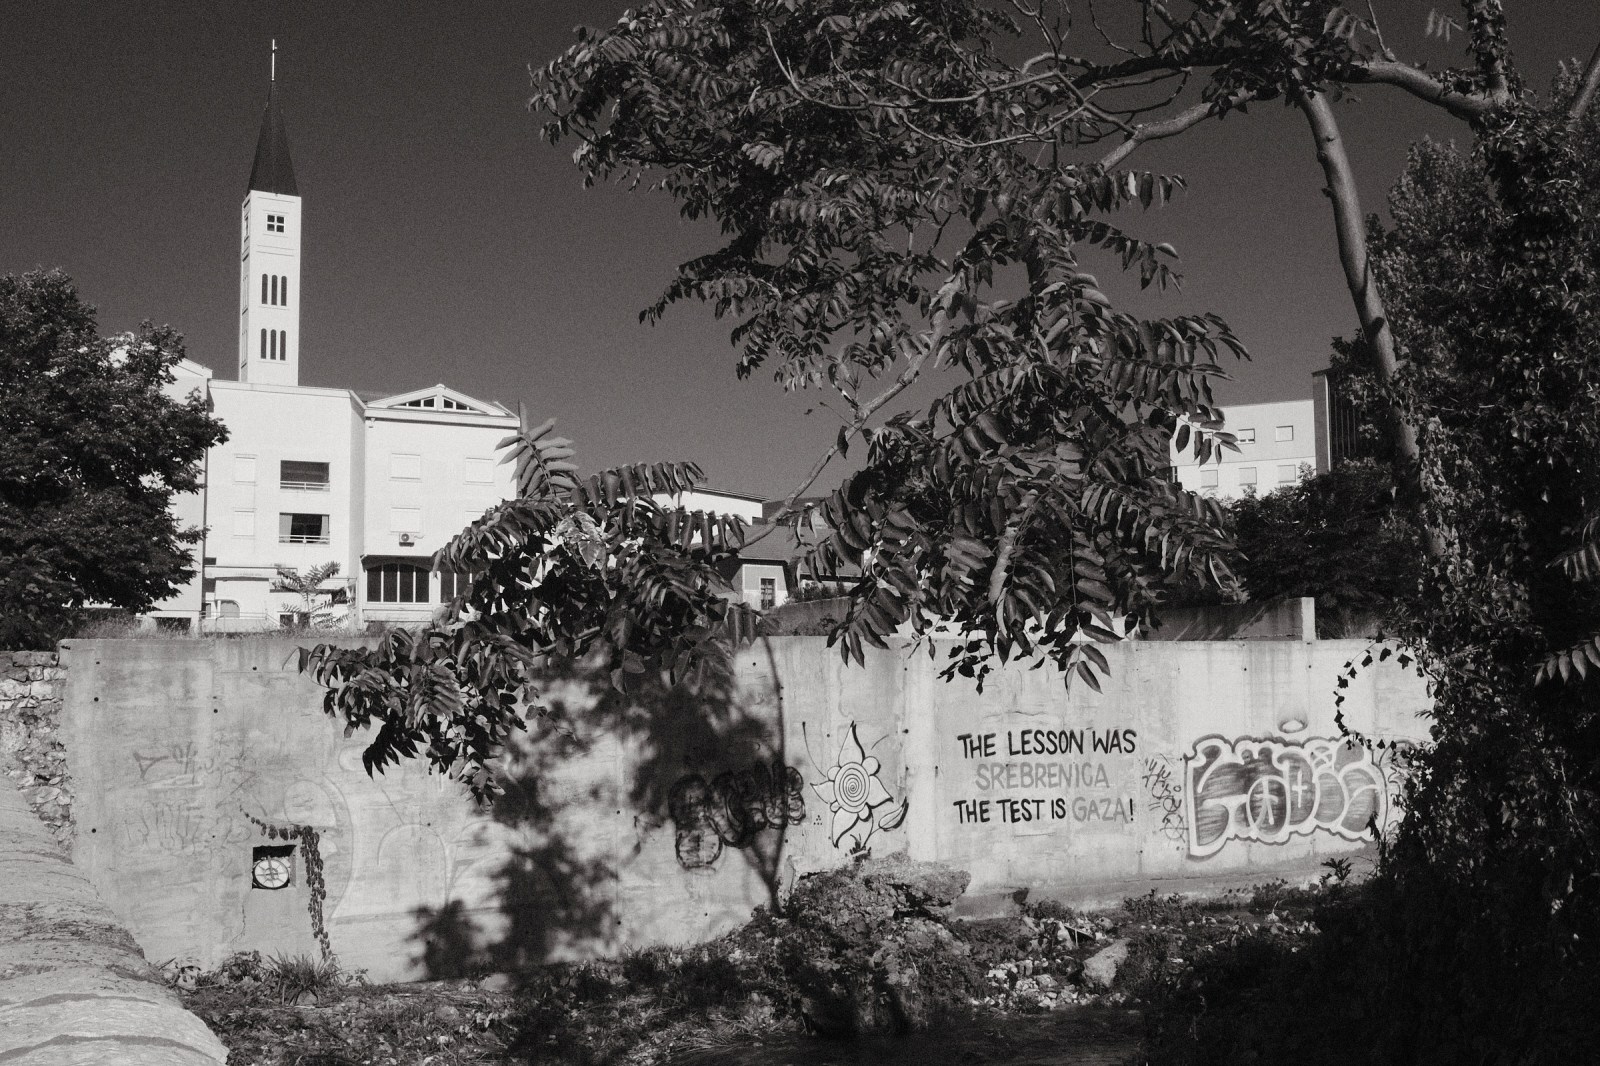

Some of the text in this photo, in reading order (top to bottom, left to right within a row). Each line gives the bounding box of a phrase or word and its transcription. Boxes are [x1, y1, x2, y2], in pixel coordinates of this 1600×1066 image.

[957, 729, 1137, 759] THE LESSON WAS
[975, 762, 1110, 790] SREBRENICA
[953, 799, 990, 824] THE
[996, 799, 1045, 823] TEST
[1051, 798, 1066, 820] IS
